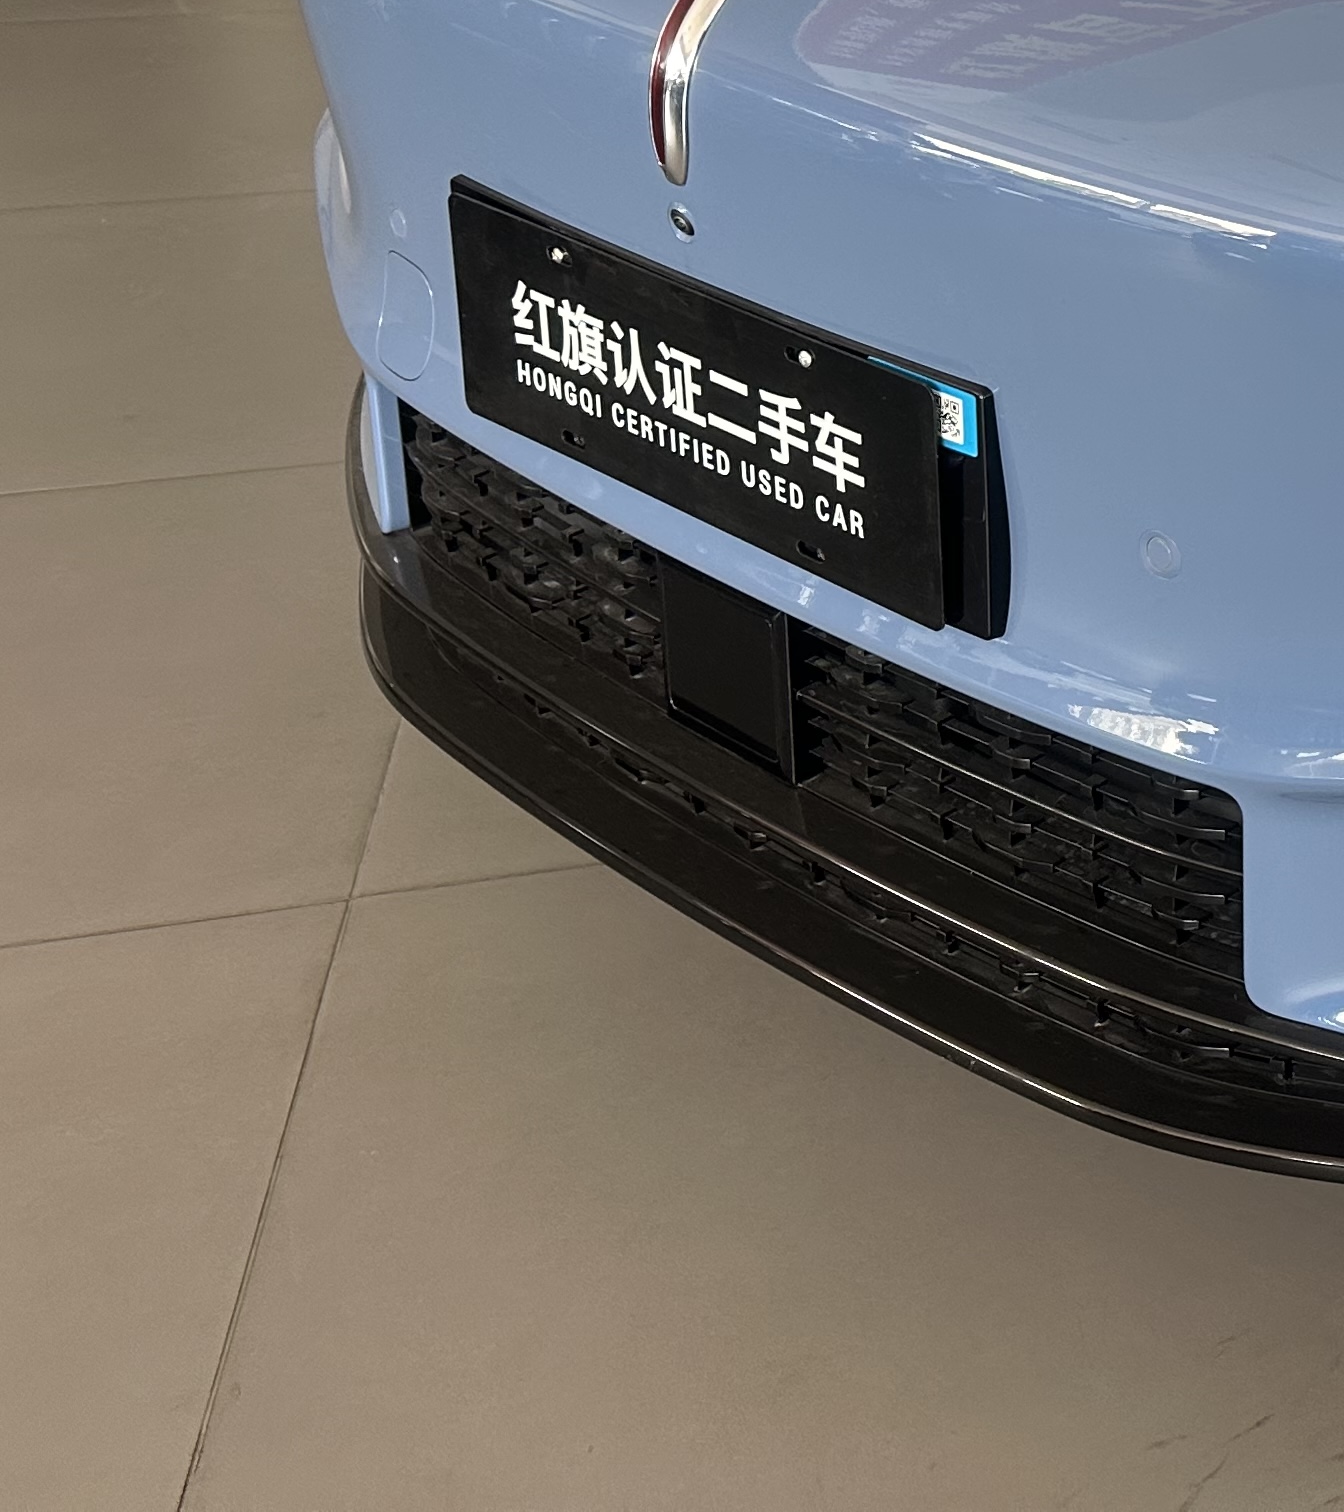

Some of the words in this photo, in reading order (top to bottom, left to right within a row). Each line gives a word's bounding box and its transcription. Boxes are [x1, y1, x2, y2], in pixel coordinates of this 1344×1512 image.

[511, 279, 867, 494] 红旗认证二手车
[517, 358, 604, 419] HONGQI
[611, 401, 731, 477] CERTIFIED
[741, 459, 805, 511] USED
[815, 494, 866, 540] CAR
